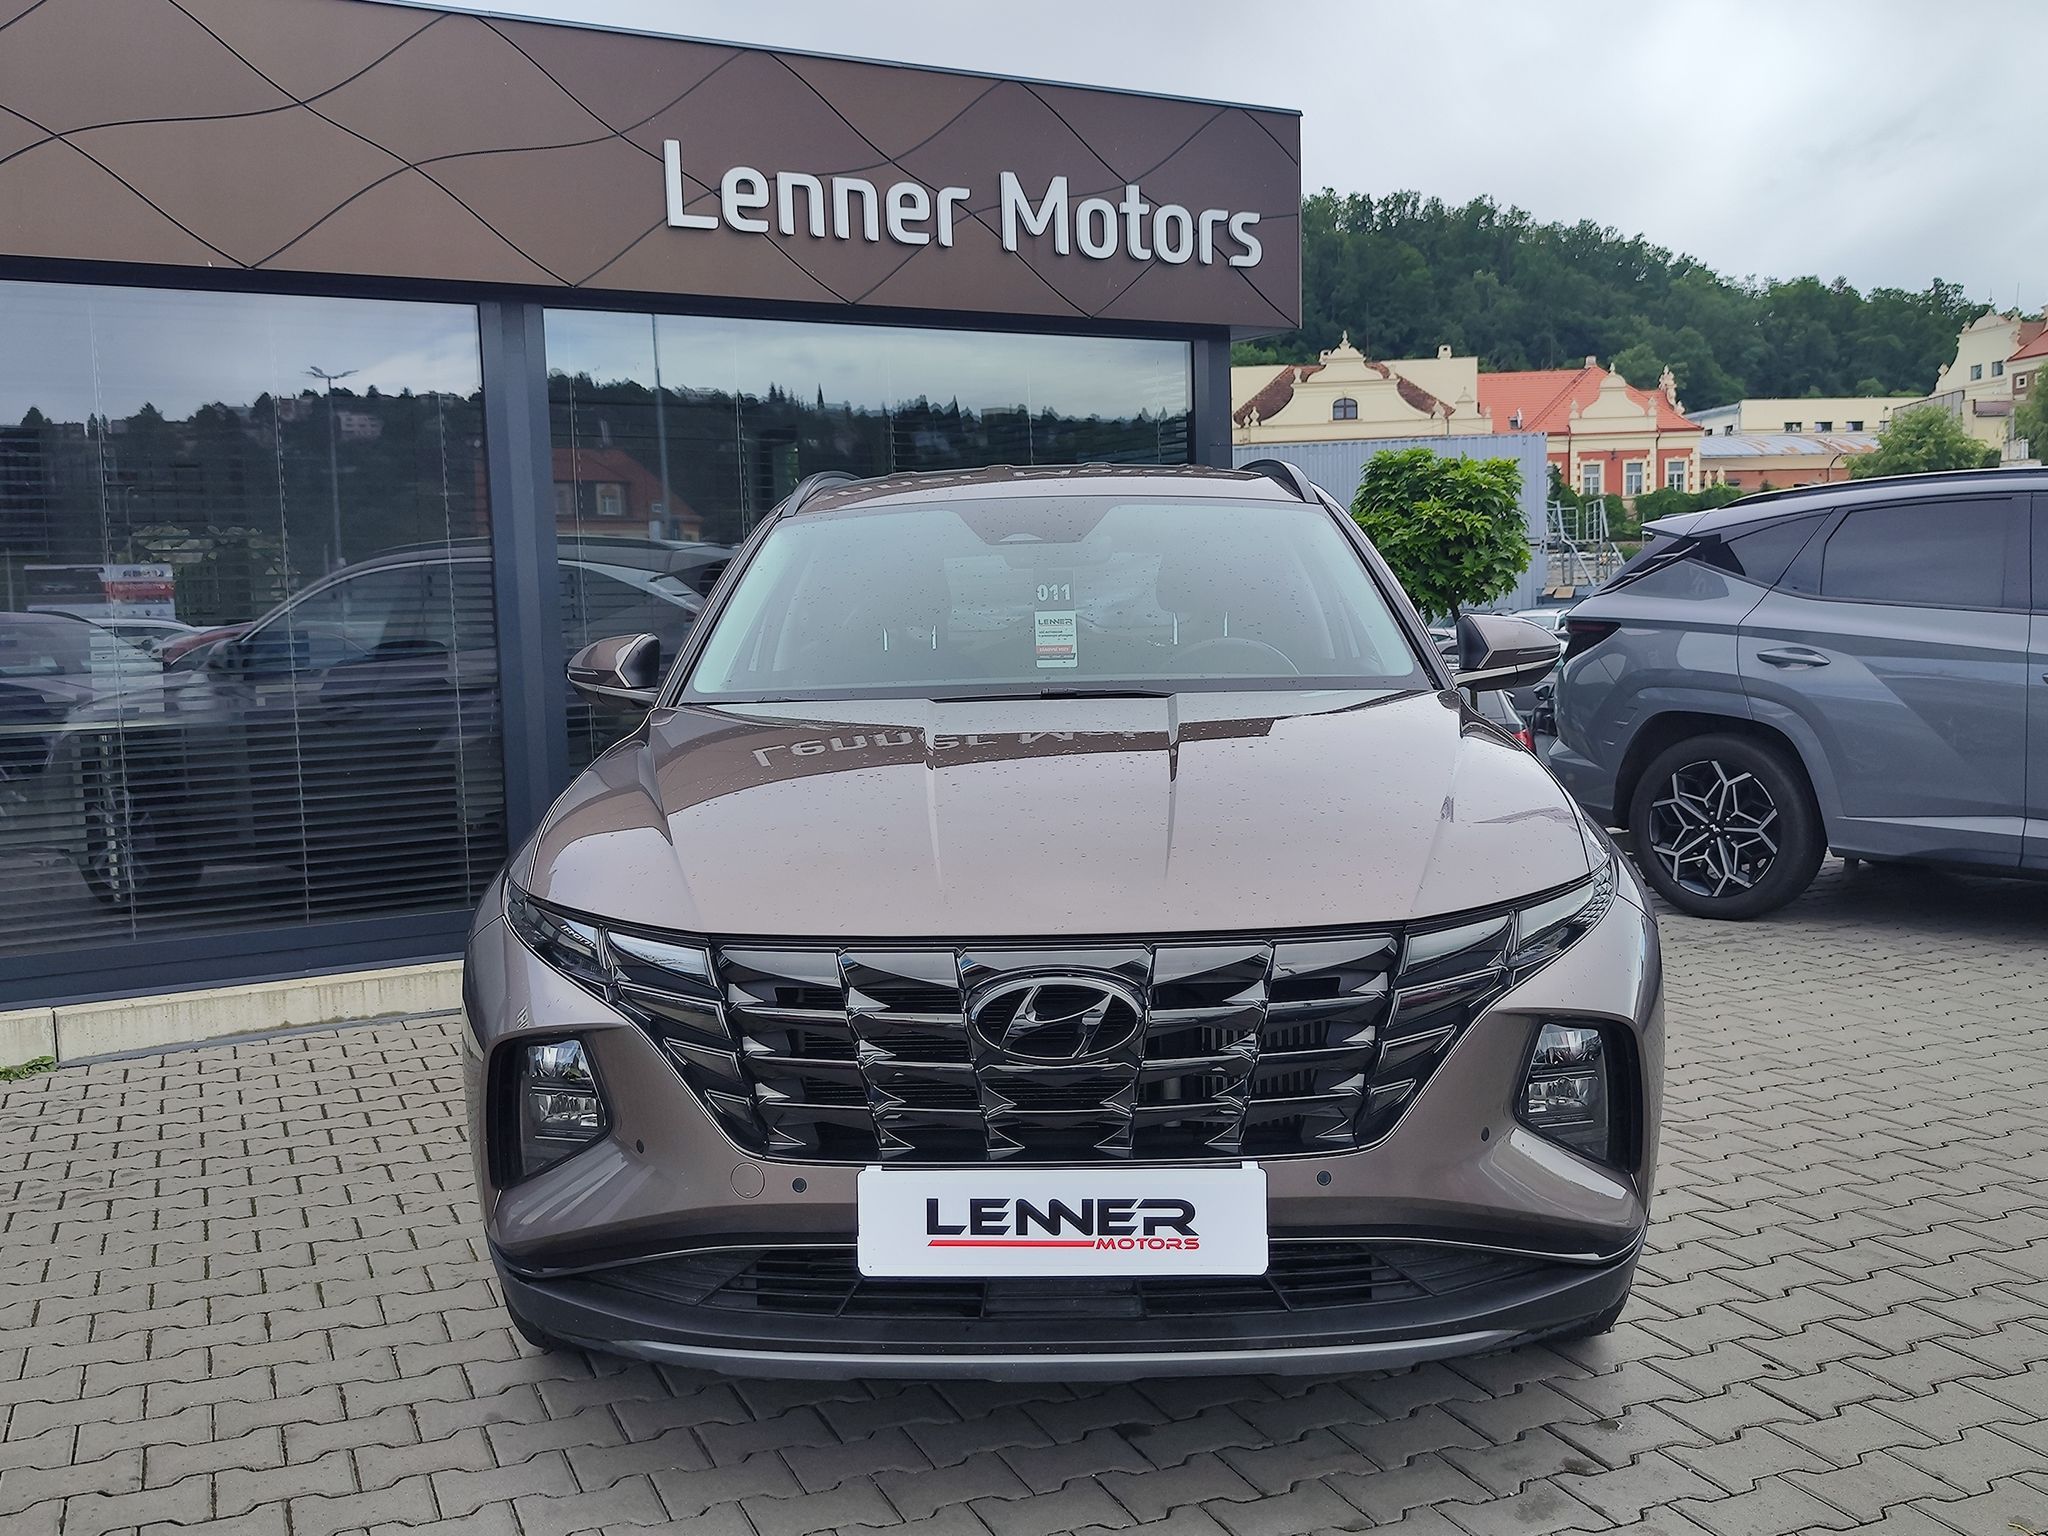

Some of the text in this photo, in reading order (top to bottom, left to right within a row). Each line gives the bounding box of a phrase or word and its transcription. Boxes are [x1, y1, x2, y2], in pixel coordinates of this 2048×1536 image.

[664, 139, 1262, 268] Lenner Motors
[1037, 584, 1070, 601] 011
[926, 1198, 1199, 1236] LENNER
[1096, 1237, 1200, 1250] MOTORS
